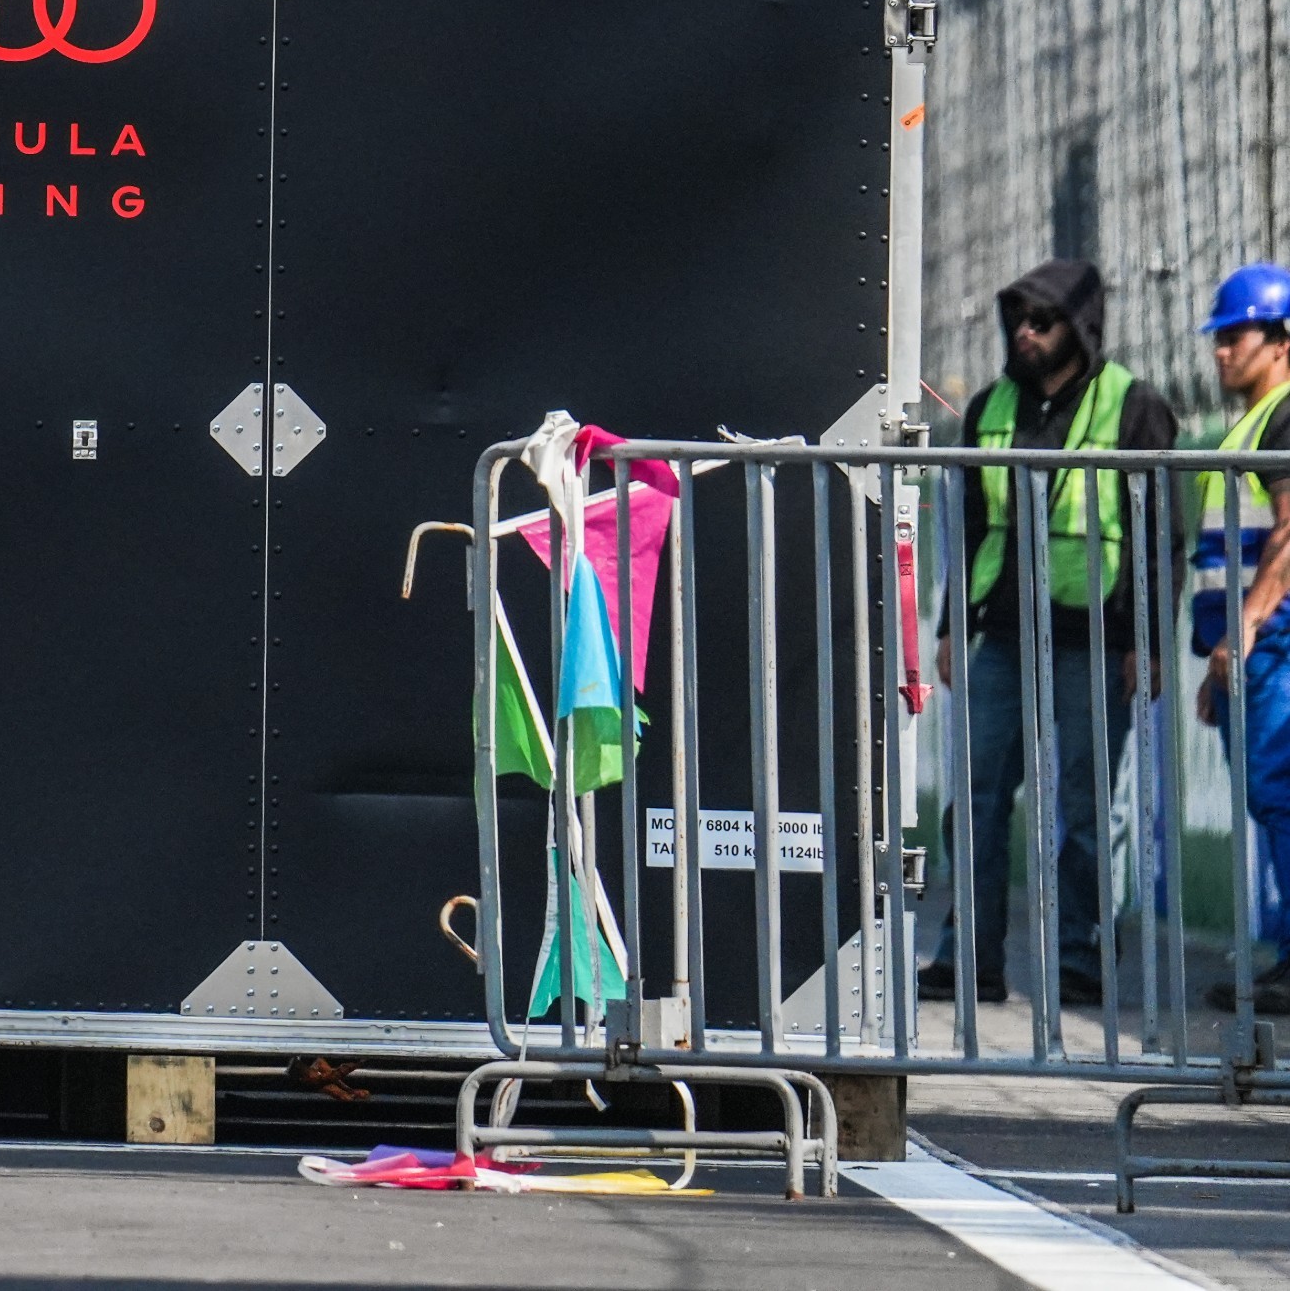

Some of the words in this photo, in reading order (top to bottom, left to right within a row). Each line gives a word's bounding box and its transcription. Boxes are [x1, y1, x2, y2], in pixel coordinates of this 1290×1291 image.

[706, 819, 740, 832] 6804
[744, 820, 756, 836] k
[778, 821, 808, 835] 5000
[714, 844, 739, 857] 510
[744, 844, 756, 860] k
